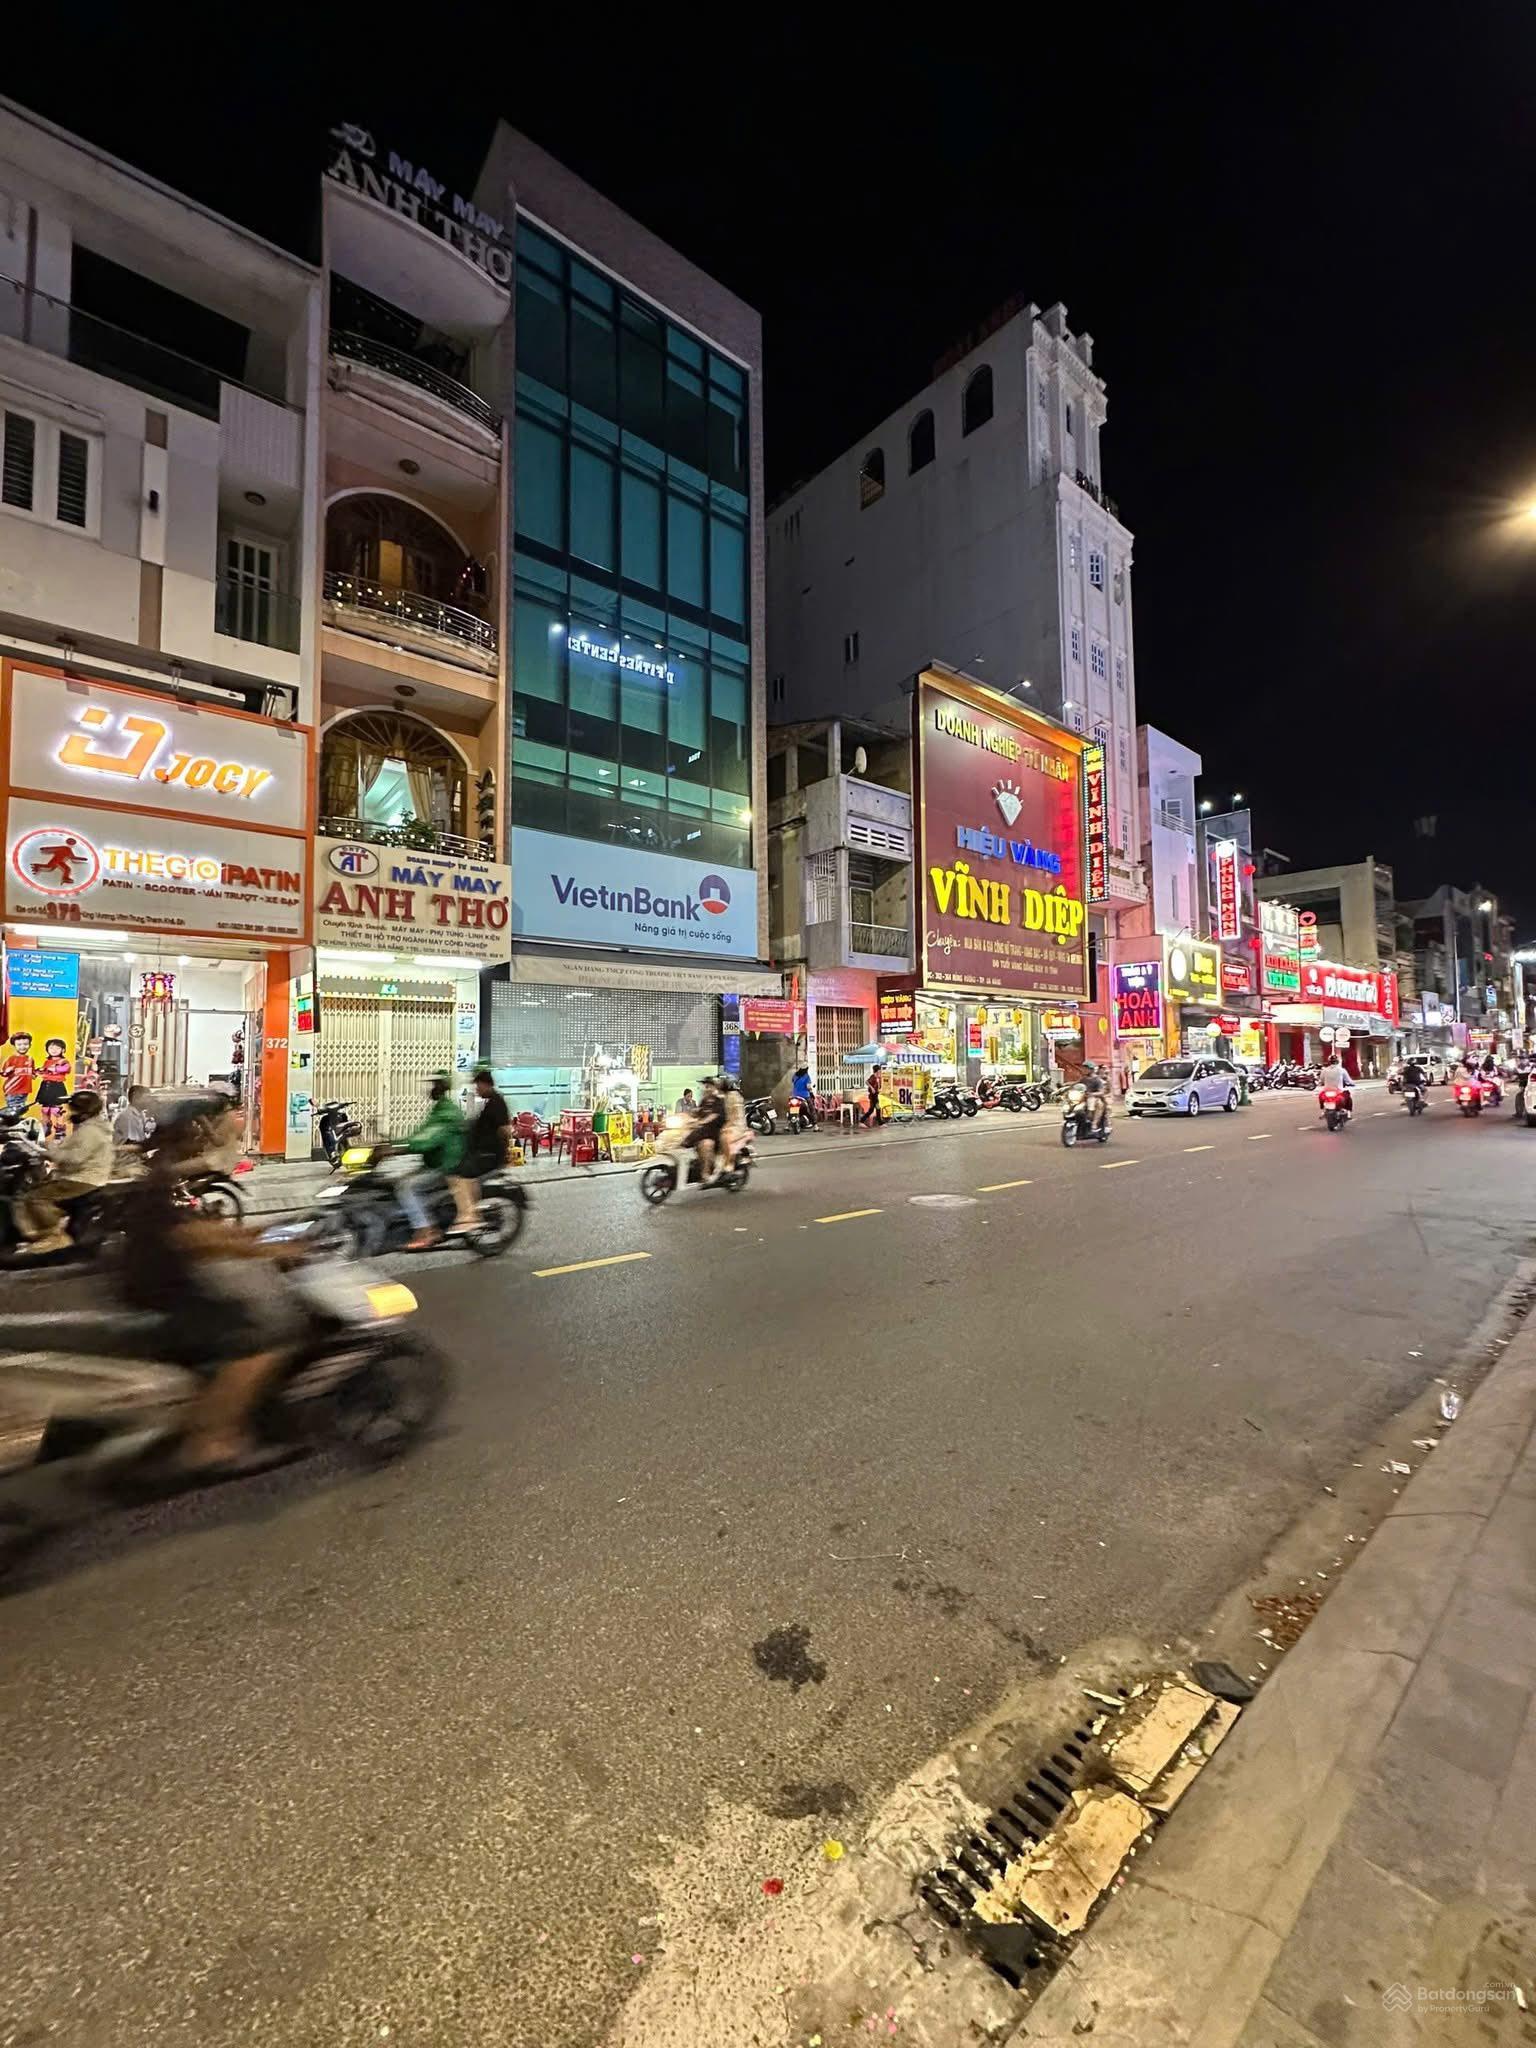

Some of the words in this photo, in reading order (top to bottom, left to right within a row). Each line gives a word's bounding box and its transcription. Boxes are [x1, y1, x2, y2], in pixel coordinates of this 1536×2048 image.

[328, 150, 421, 223] ANH
[935, 708, 978, 746] DOANH
[981, 727, 1021, 765] NGHIỆP
[154, 753, 271, 797] JOCY
[956, 825, 1006, 860] HIỆU
[1010, 839, 1061, 874] VÀNG
[102, 878, 133, 889] PATIN
[144, 883, 196, 896] SCOOTER
[391, 866, 444, 888] MÁY
[454, 875, 502, 895] MAY
[551, 874, 702, 922] VietinBank
[319, 881, 415, 923] ANH
[432, 893, 509, 930] THƠ
[930, 861, 1011, 925] VĨNH
[1023, 885, 1084, 945] DIỆP
[341, 930, 362, 938] THIẾT
[634, 922, 659, 936] Nâng
[661, 925, 676, 936] giá
[678, 926, 687, 939] trị
[689, 929, 710, 941] cuộc
[712, 930, 732, 943] sống
[1117, 988, 1158, 1009] HOÀI
[1120, 1009, 1158, 1028] ANH
[266, 1038, 288, 1049] 372
